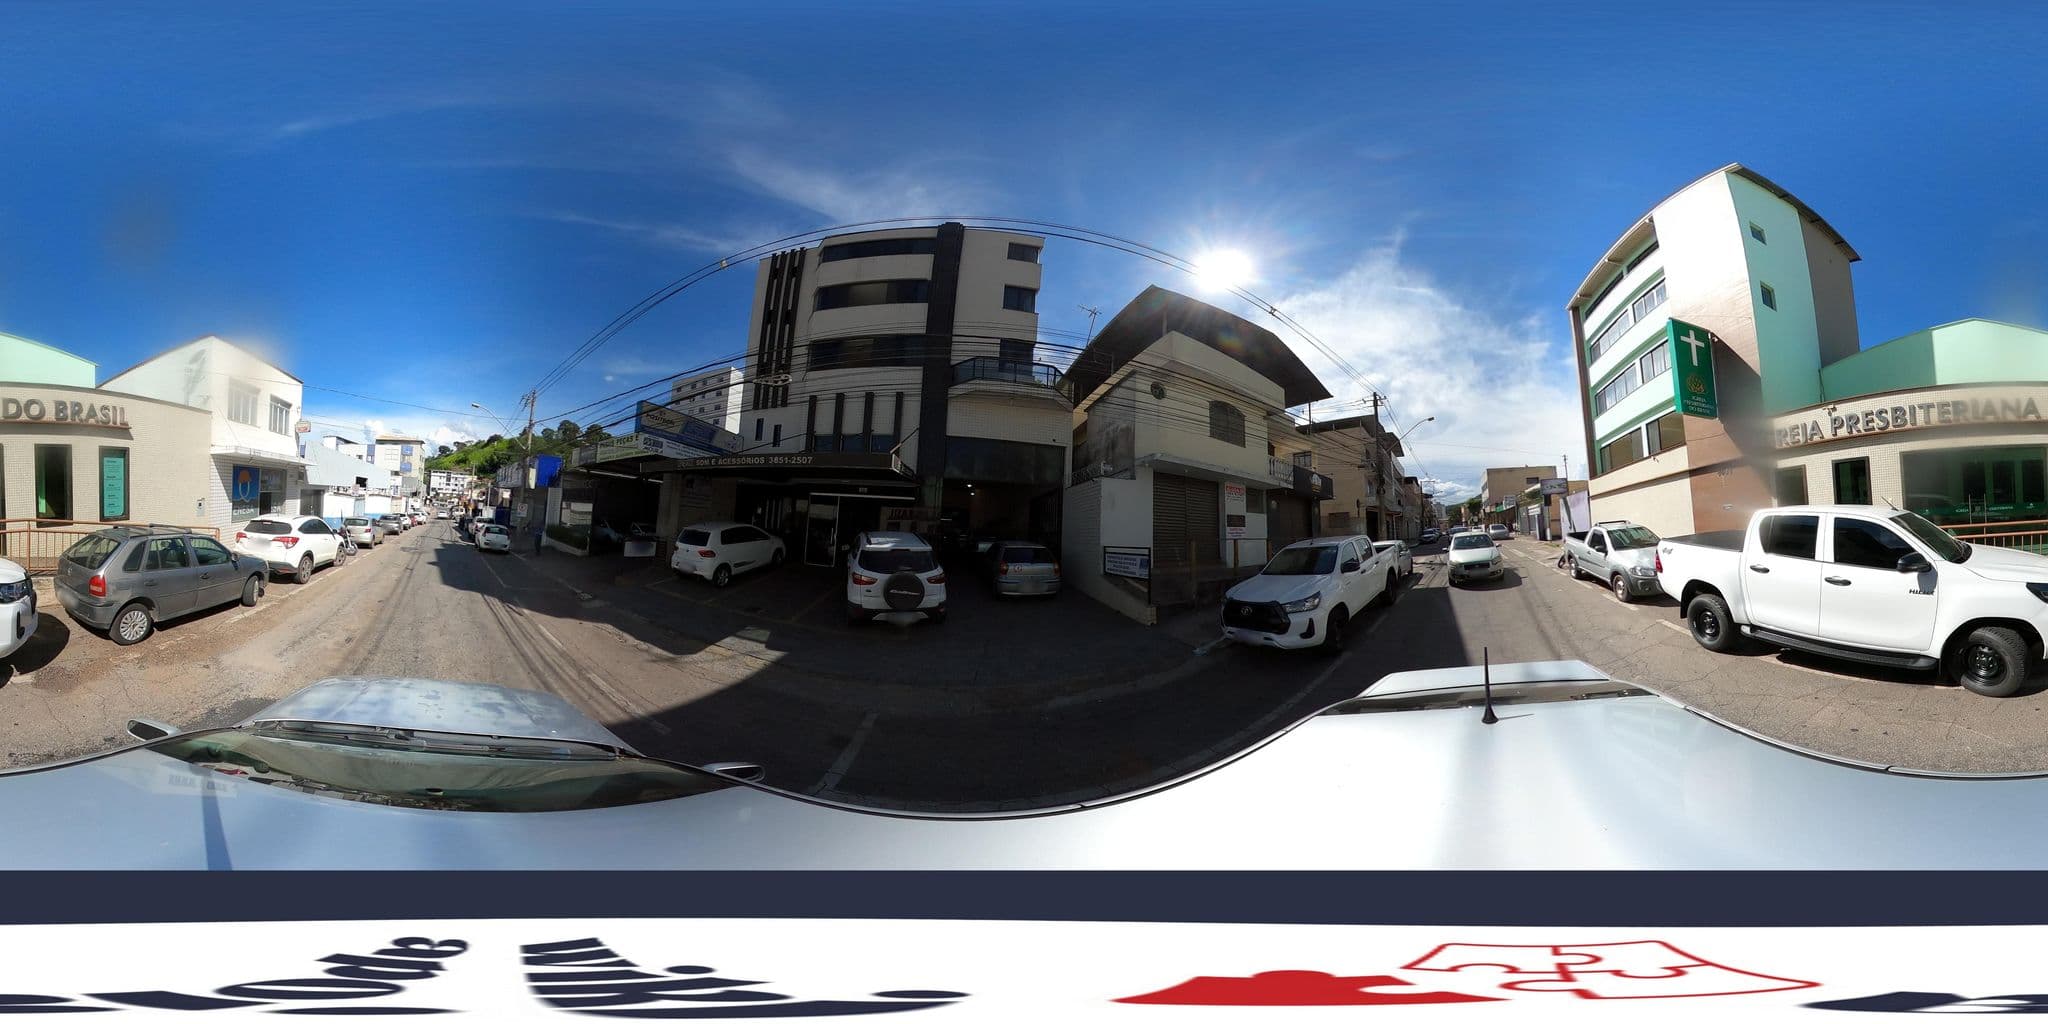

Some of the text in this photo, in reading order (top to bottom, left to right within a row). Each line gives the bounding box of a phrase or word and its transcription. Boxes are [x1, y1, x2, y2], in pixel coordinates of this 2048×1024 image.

[1, 397, 129, 427] DO BRASIL
[1830, 396, 2042, 437] PRESBITERIANA
[768, 456, 813, 464] 3851-2507
